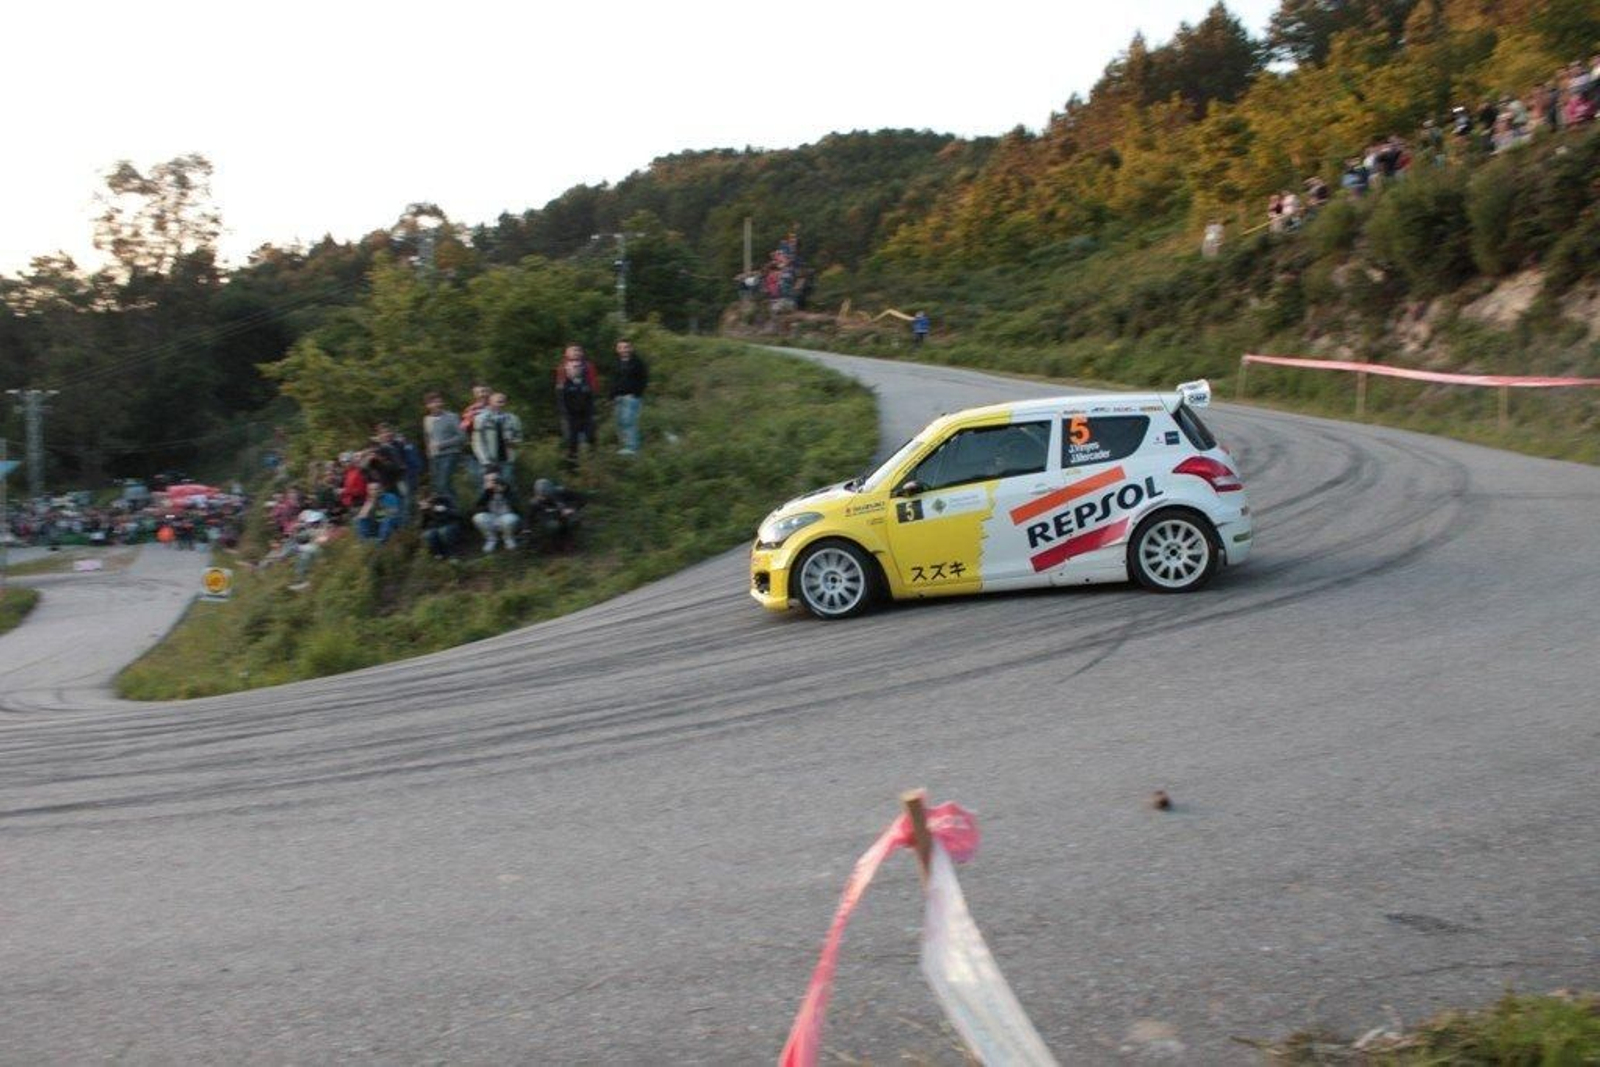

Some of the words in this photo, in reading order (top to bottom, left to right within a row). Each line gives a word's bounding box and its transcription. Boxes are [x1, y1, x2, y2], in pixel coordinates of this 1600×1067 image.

[1069, 414, 1091, 445] 5
[904, 502, 915, 521] 5
[1027, 476, 1164, 549] REPSOL
[911, 561, 966, 582] スズキ
